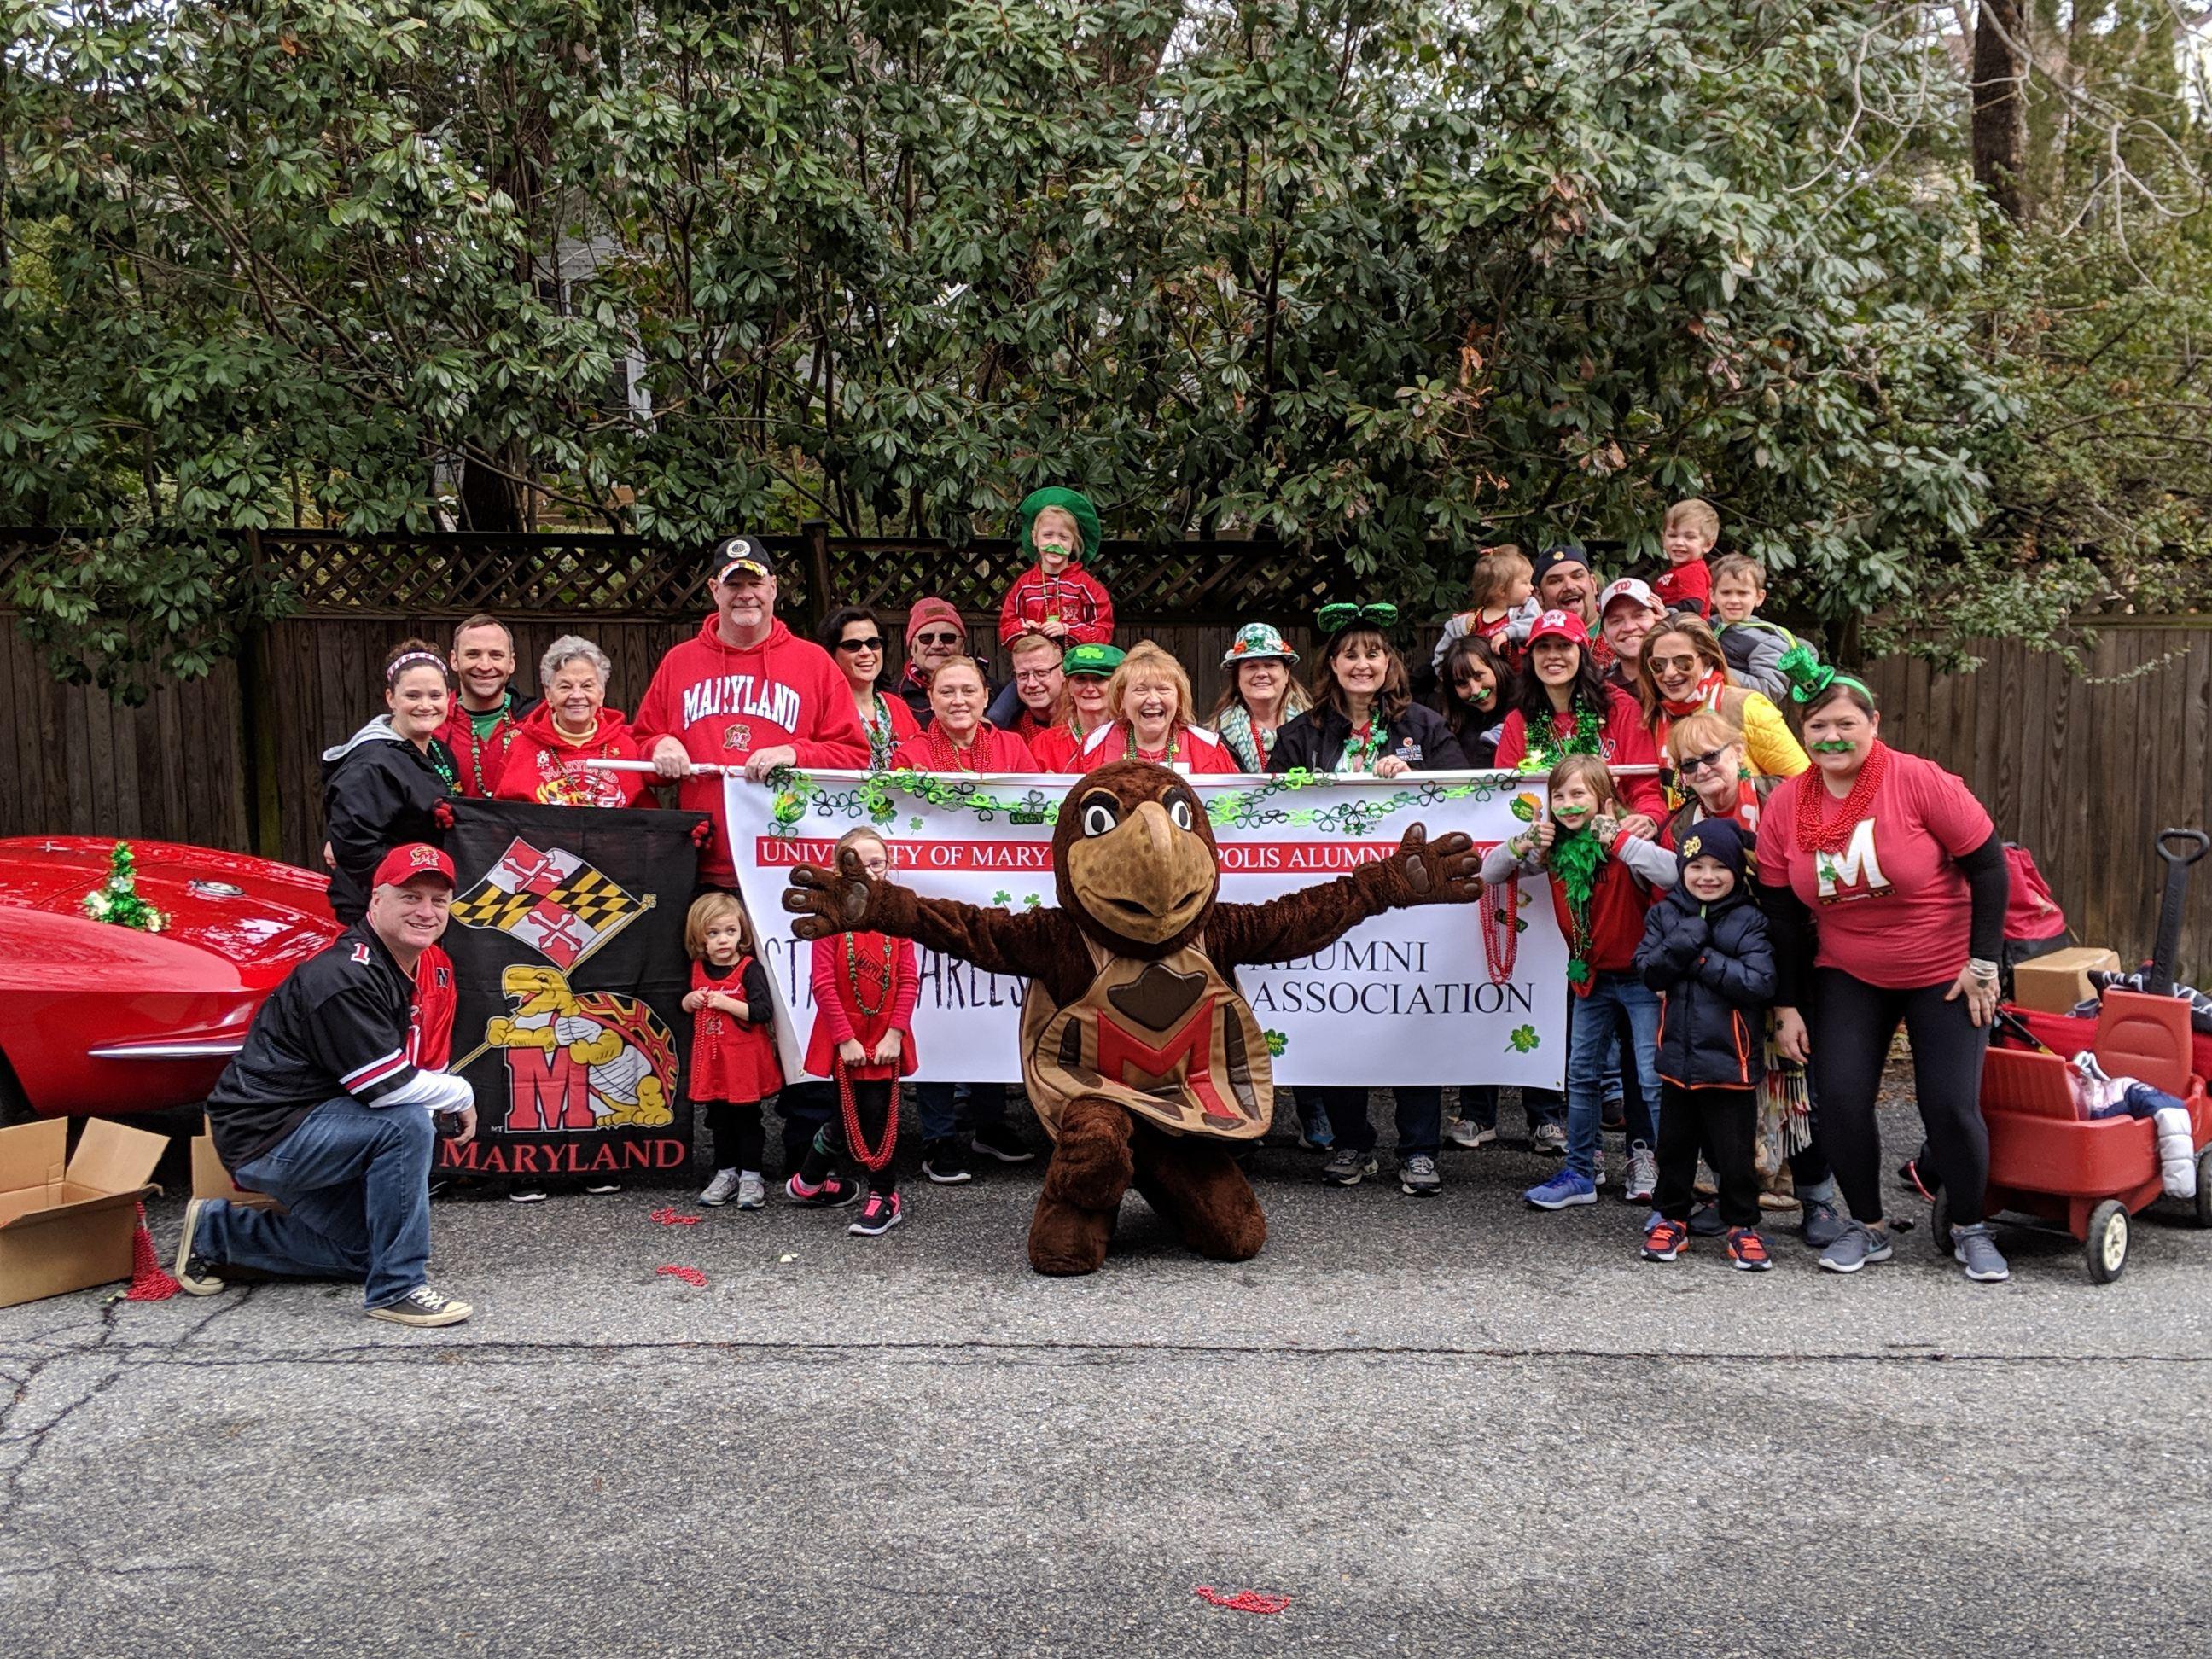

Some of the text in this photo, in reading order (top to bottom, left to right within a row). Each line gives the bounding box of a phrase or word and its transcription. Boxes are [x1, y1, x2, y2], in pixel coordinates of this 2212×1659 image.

[683, 674, 800, 735] MARYLAND
[762, 841, 924, 865] UNIVTY
[930, 845, 964, 866] OF
[971, 845, 1051, 867] MARY
[1815, 816, 1891, 898] M
[1249, 940, 1429, 973] UMNI
[1251, 981, 1535, 1015] ASSOCIATION
[439, 1138, 686, 1173] MARYLAND
